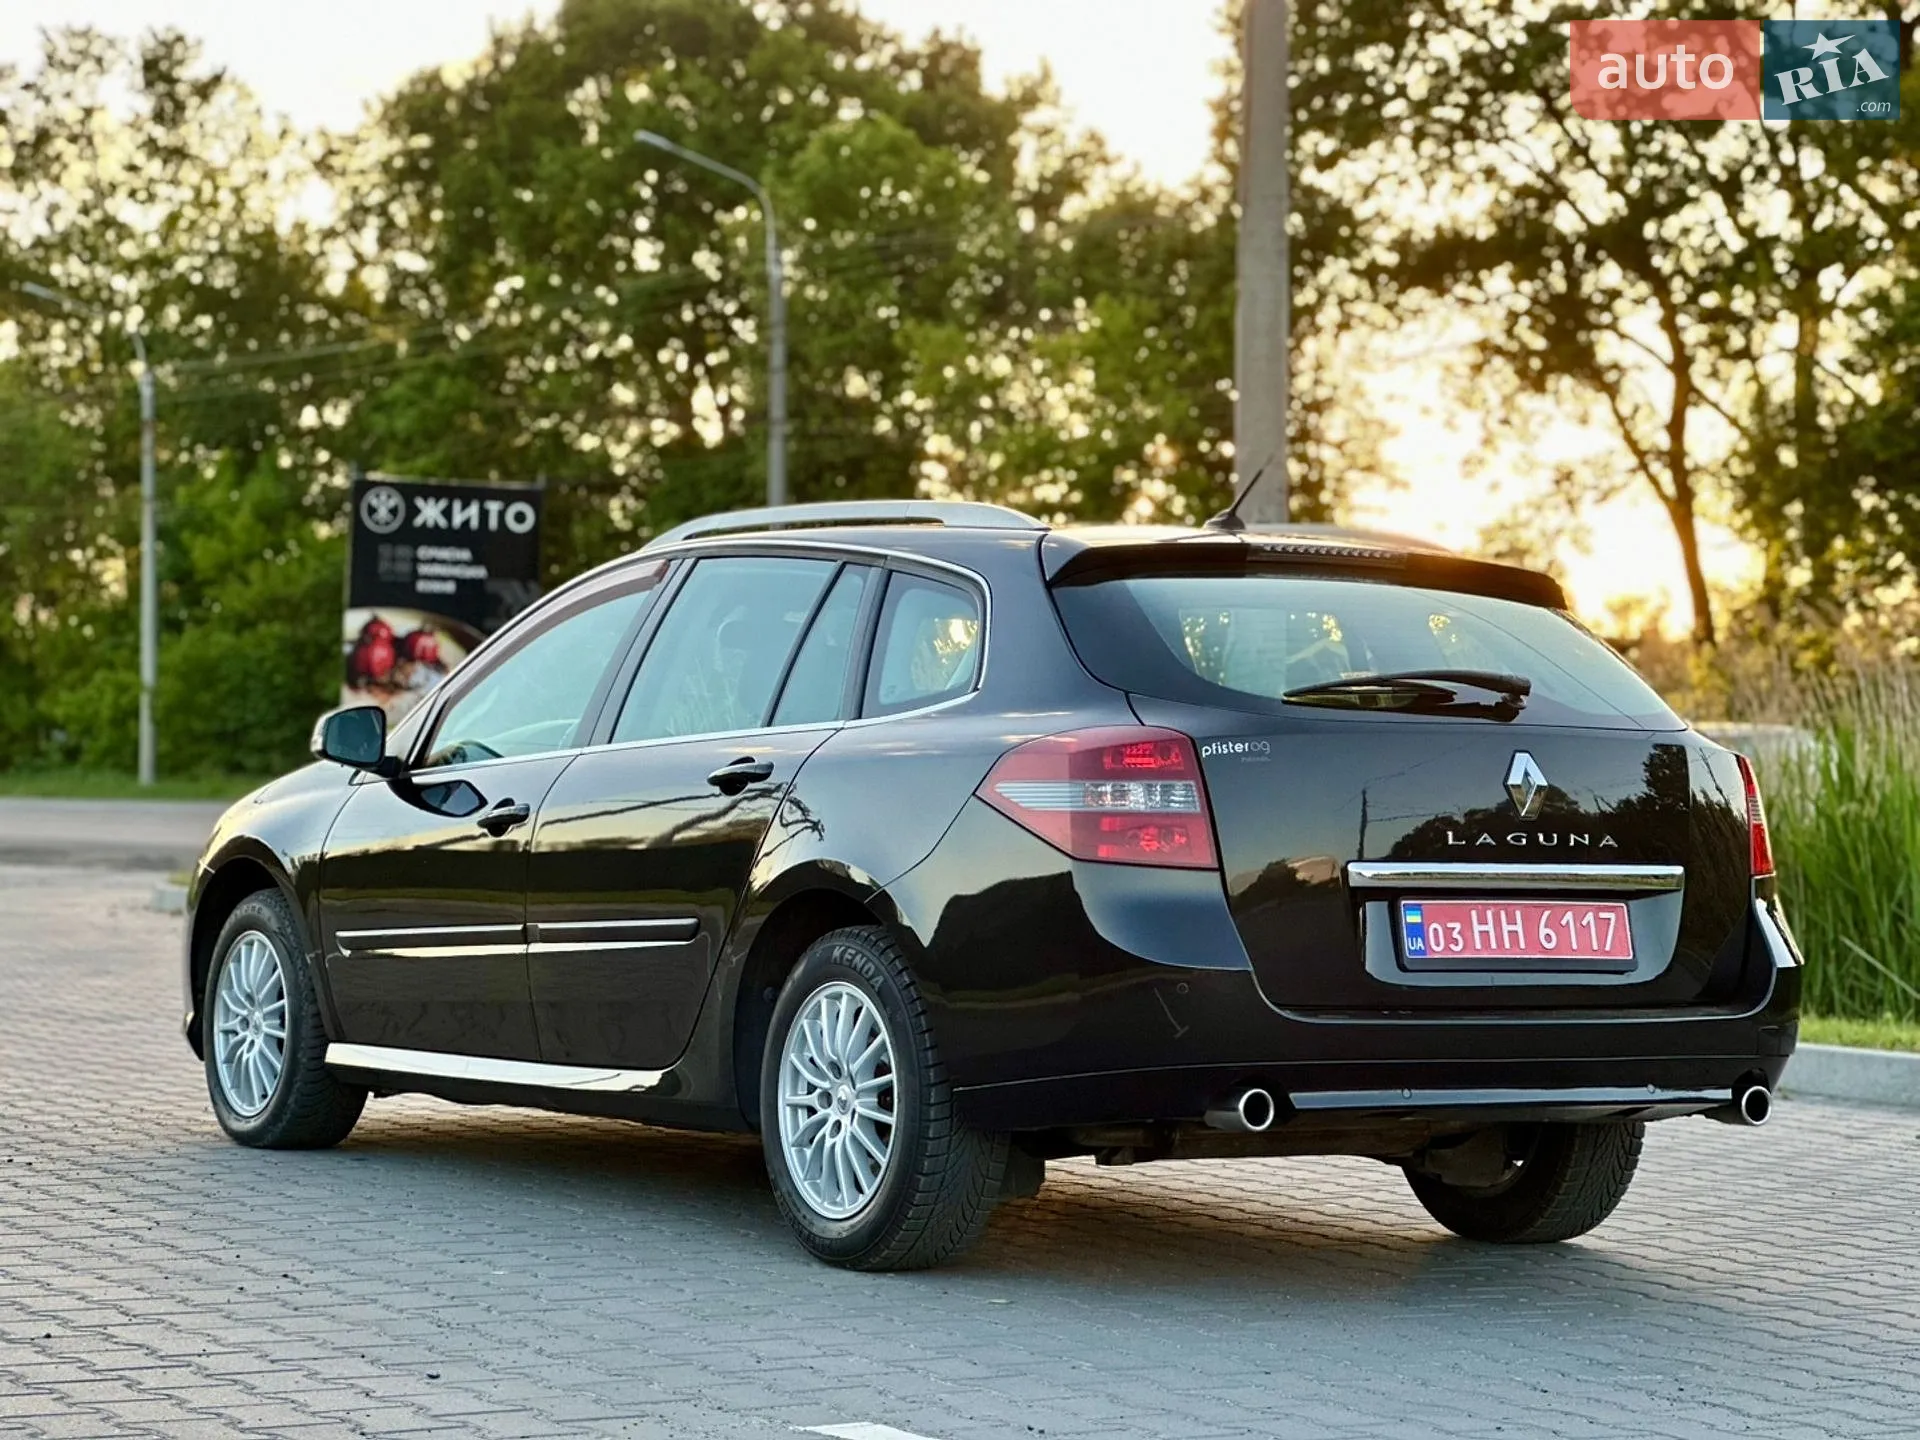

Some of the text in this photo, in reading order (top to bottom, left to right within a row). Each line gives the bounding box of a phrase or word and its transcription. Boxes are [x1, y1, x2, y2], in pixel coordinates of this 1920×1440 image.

[412, 495, 536, 534] ЖИТО
[1446, 830, 1618, 848] LAGUNA
[1408, 909, 1616, 952] UA 03 HH 6117
[831, 946, 884, 992] KENDA
